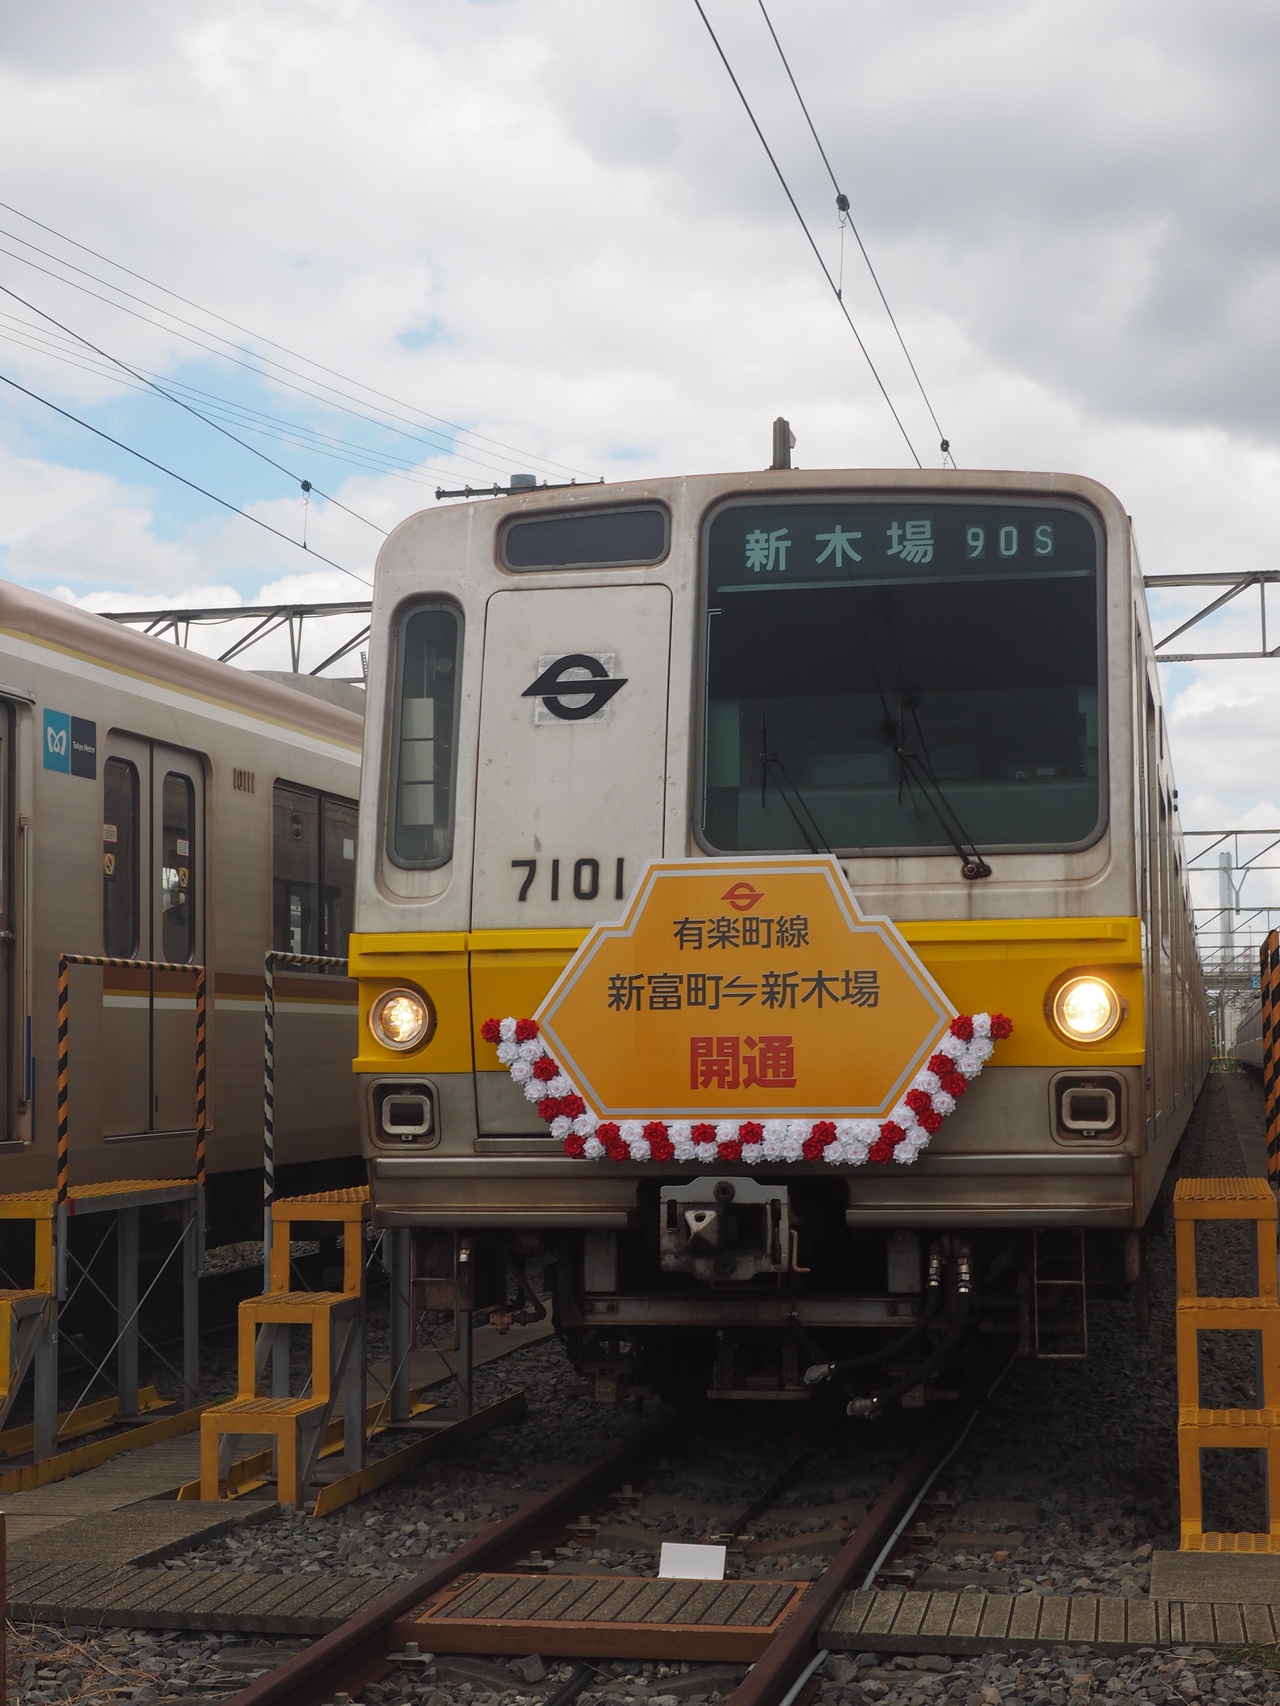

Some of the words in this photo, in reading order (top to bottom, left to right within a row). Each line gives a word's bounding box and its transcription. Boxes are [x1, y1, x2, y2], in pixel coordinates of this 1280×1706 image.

[745, 520, 934, 572] 新木場
[72, 741, 83, 752] Tokyo
[84, 744, 95, 754] Metro
[511, 857, 624, 902] 7101
[673, 915, 809, 950] 有楽町線
[690, 1035, 797, 1090] 開通
